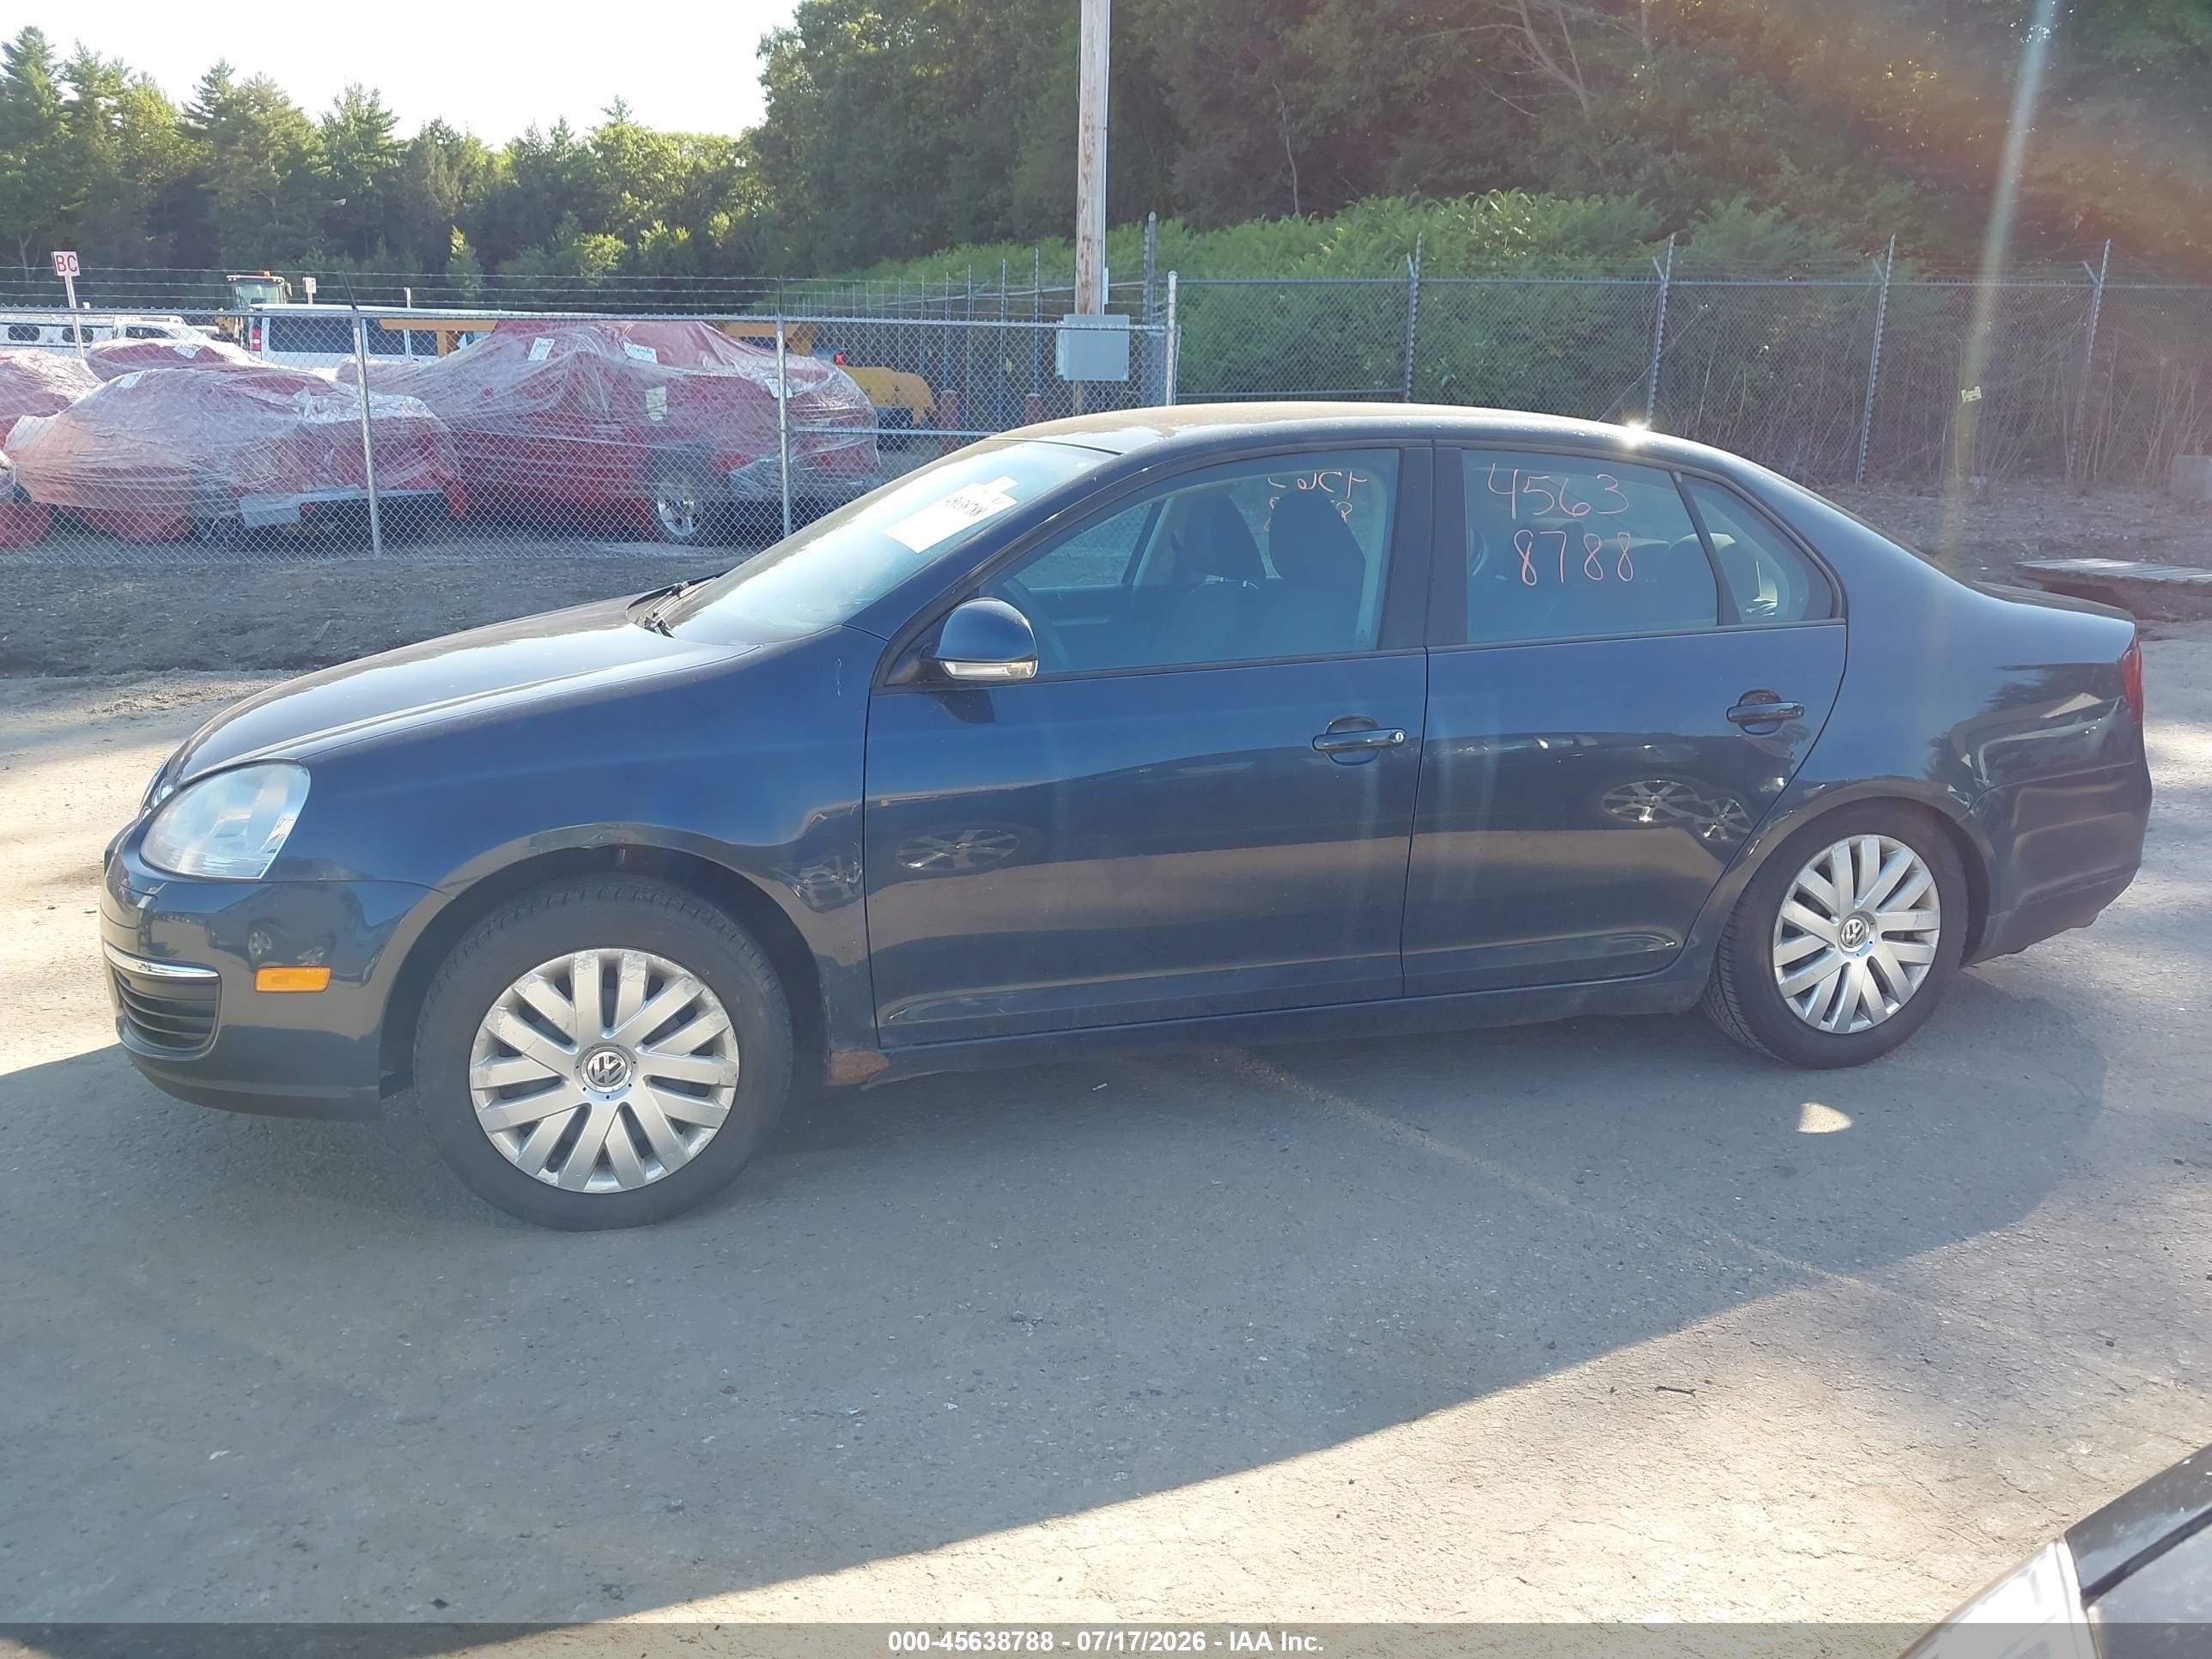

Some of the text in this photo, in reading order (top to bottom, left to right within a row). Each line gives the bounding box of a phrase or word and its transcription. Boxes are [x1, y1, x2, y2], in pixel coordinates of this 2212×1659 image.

[55, 254, 78, 272] BC
[1487, 463, 1630, 520] 4563
[1513, 529, 1634, 586] 8788
[586, 1050, 628, 1088] VW
